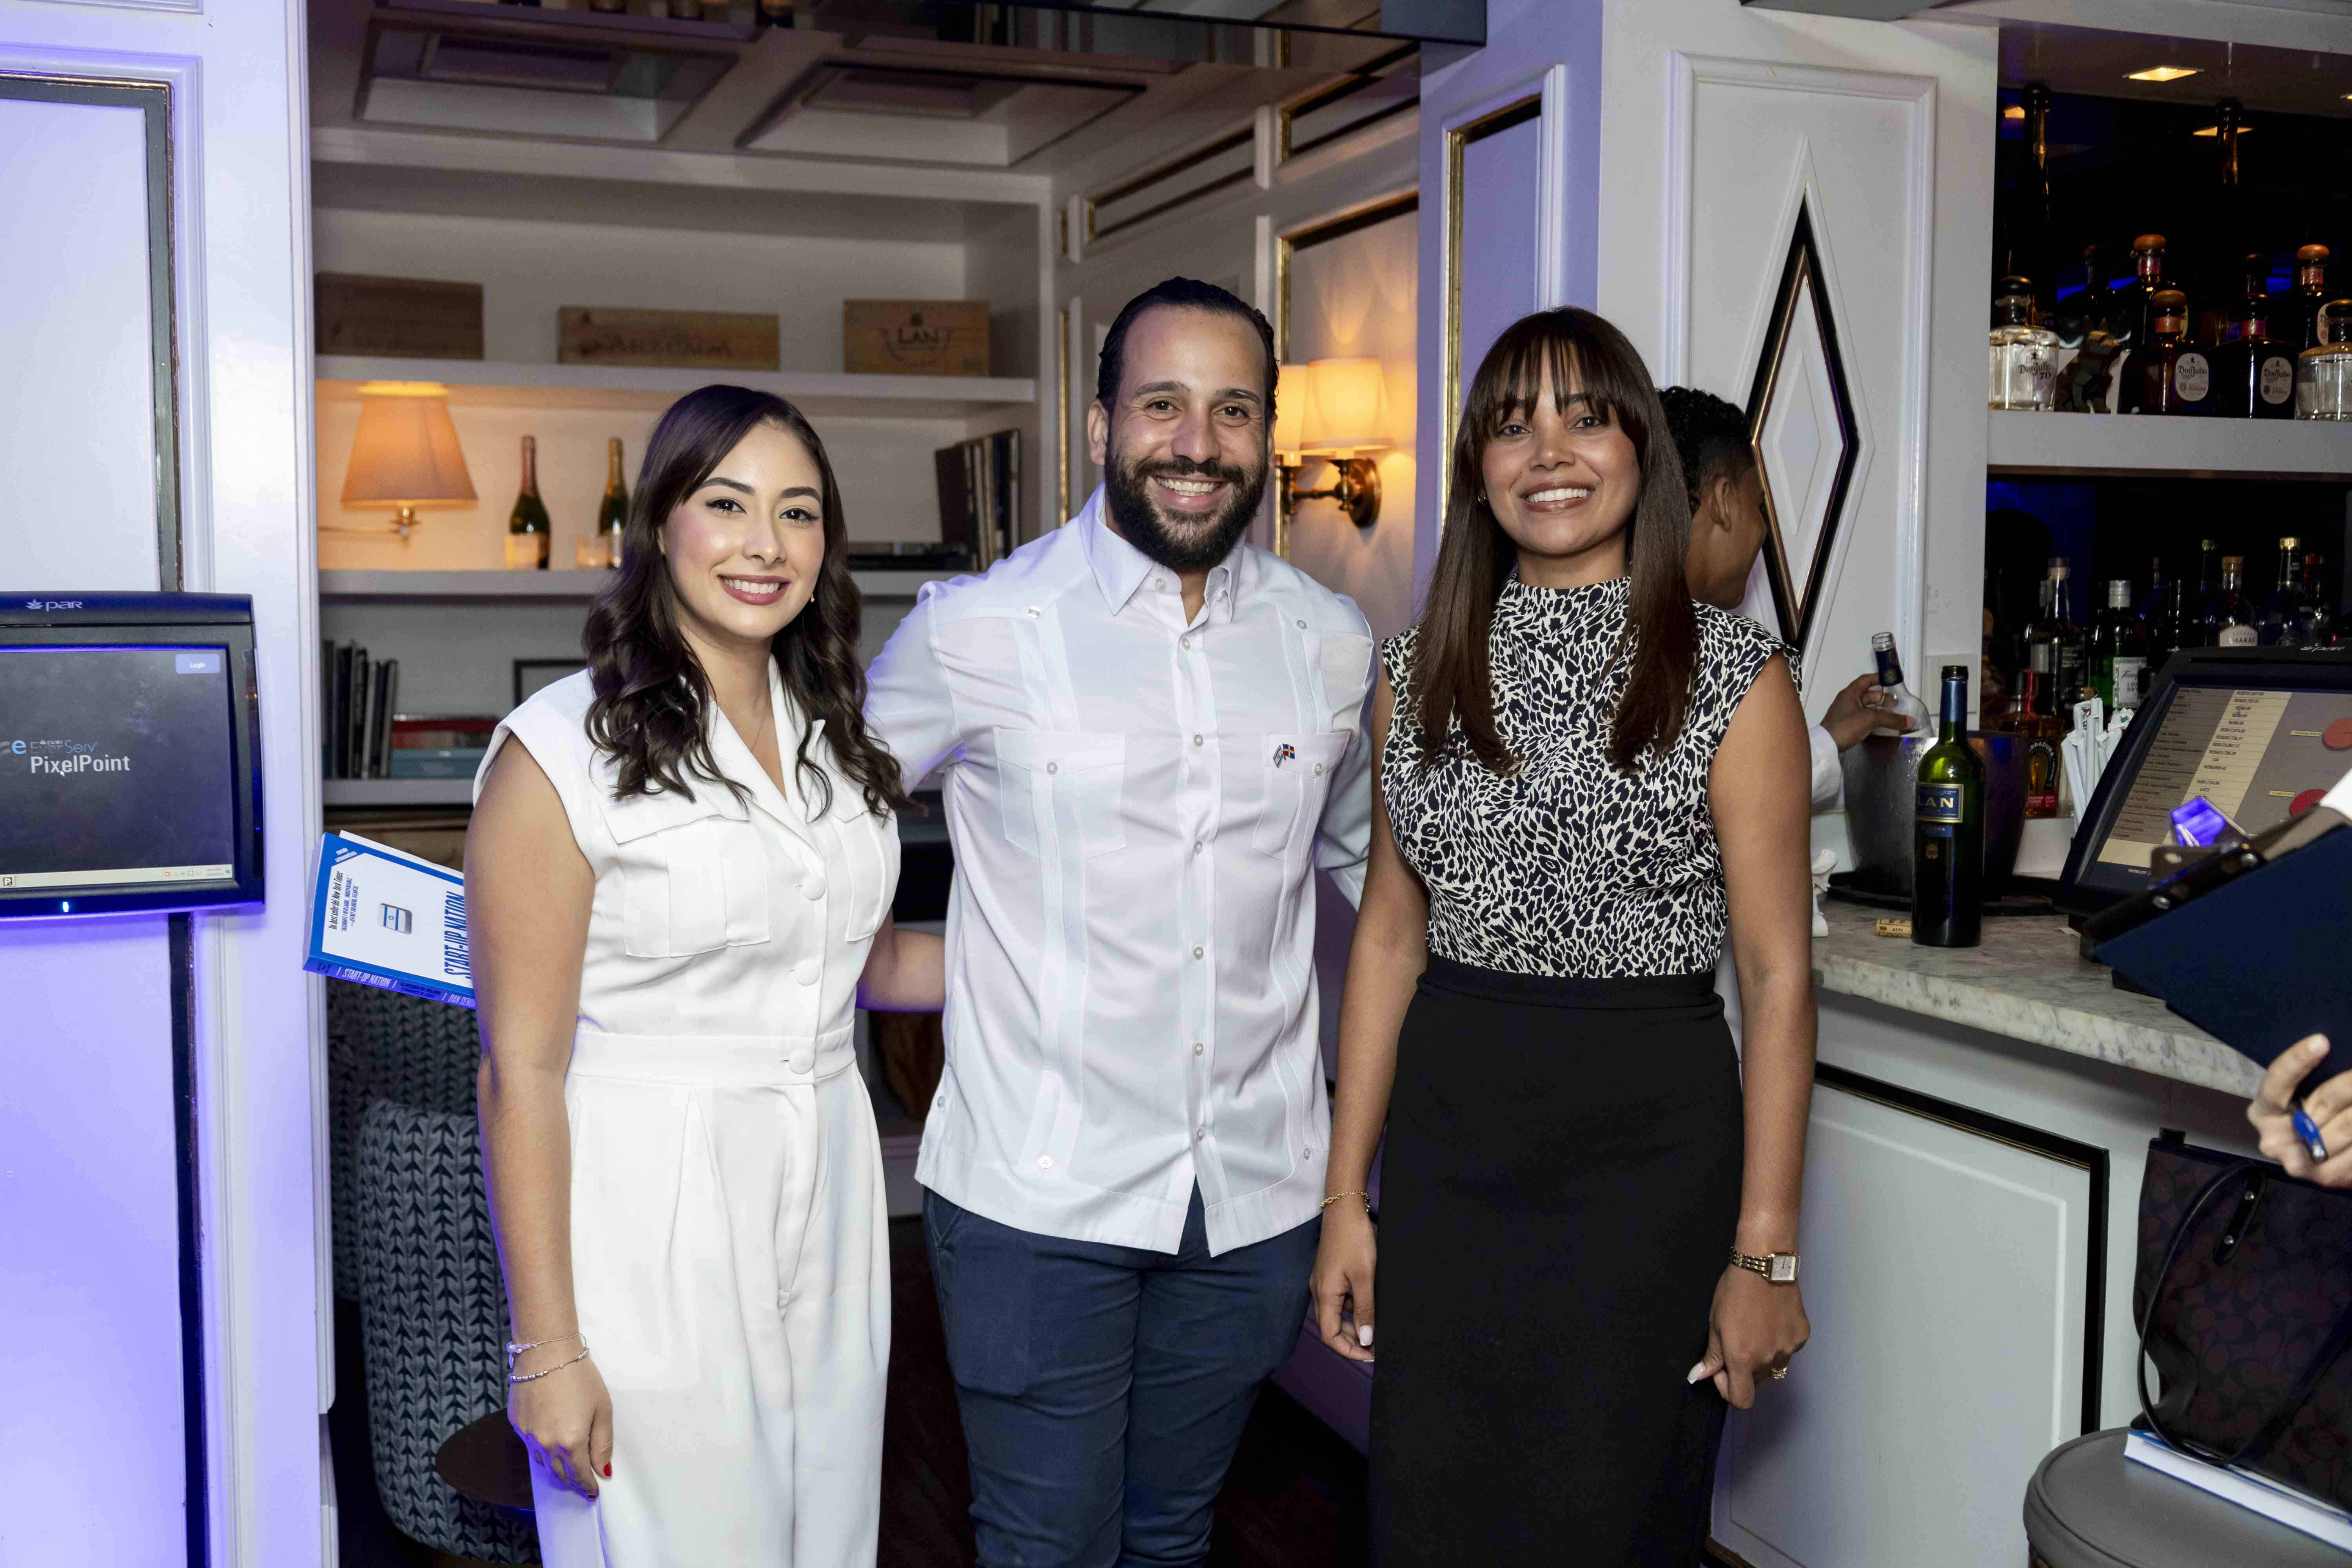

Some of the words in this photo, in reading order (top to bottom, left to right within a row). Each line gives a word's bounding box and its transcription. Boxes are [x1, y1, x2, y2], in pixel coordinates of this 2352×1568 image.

[46, 600, 83, 612] par
[189, 661, 207, 669] Login
[2030, 742, 2055, 757] RRADURA
[31, 754, 131, 774] PixelPoint
[334, 871, 343, 883] Times
[332, 882, 342, 891] York
[332, 891, 340, 899] New
[330, 905, 339, 916] seller
[444, 891, 467, 931] NATION
[328, 915, 338, 924] best
[444, 931, 469, 976] START-UP
[342, 968, 370, 983] START-UP
[369, 974, 391, 987] NATION
[448, 993, 461, 1004] DAN
